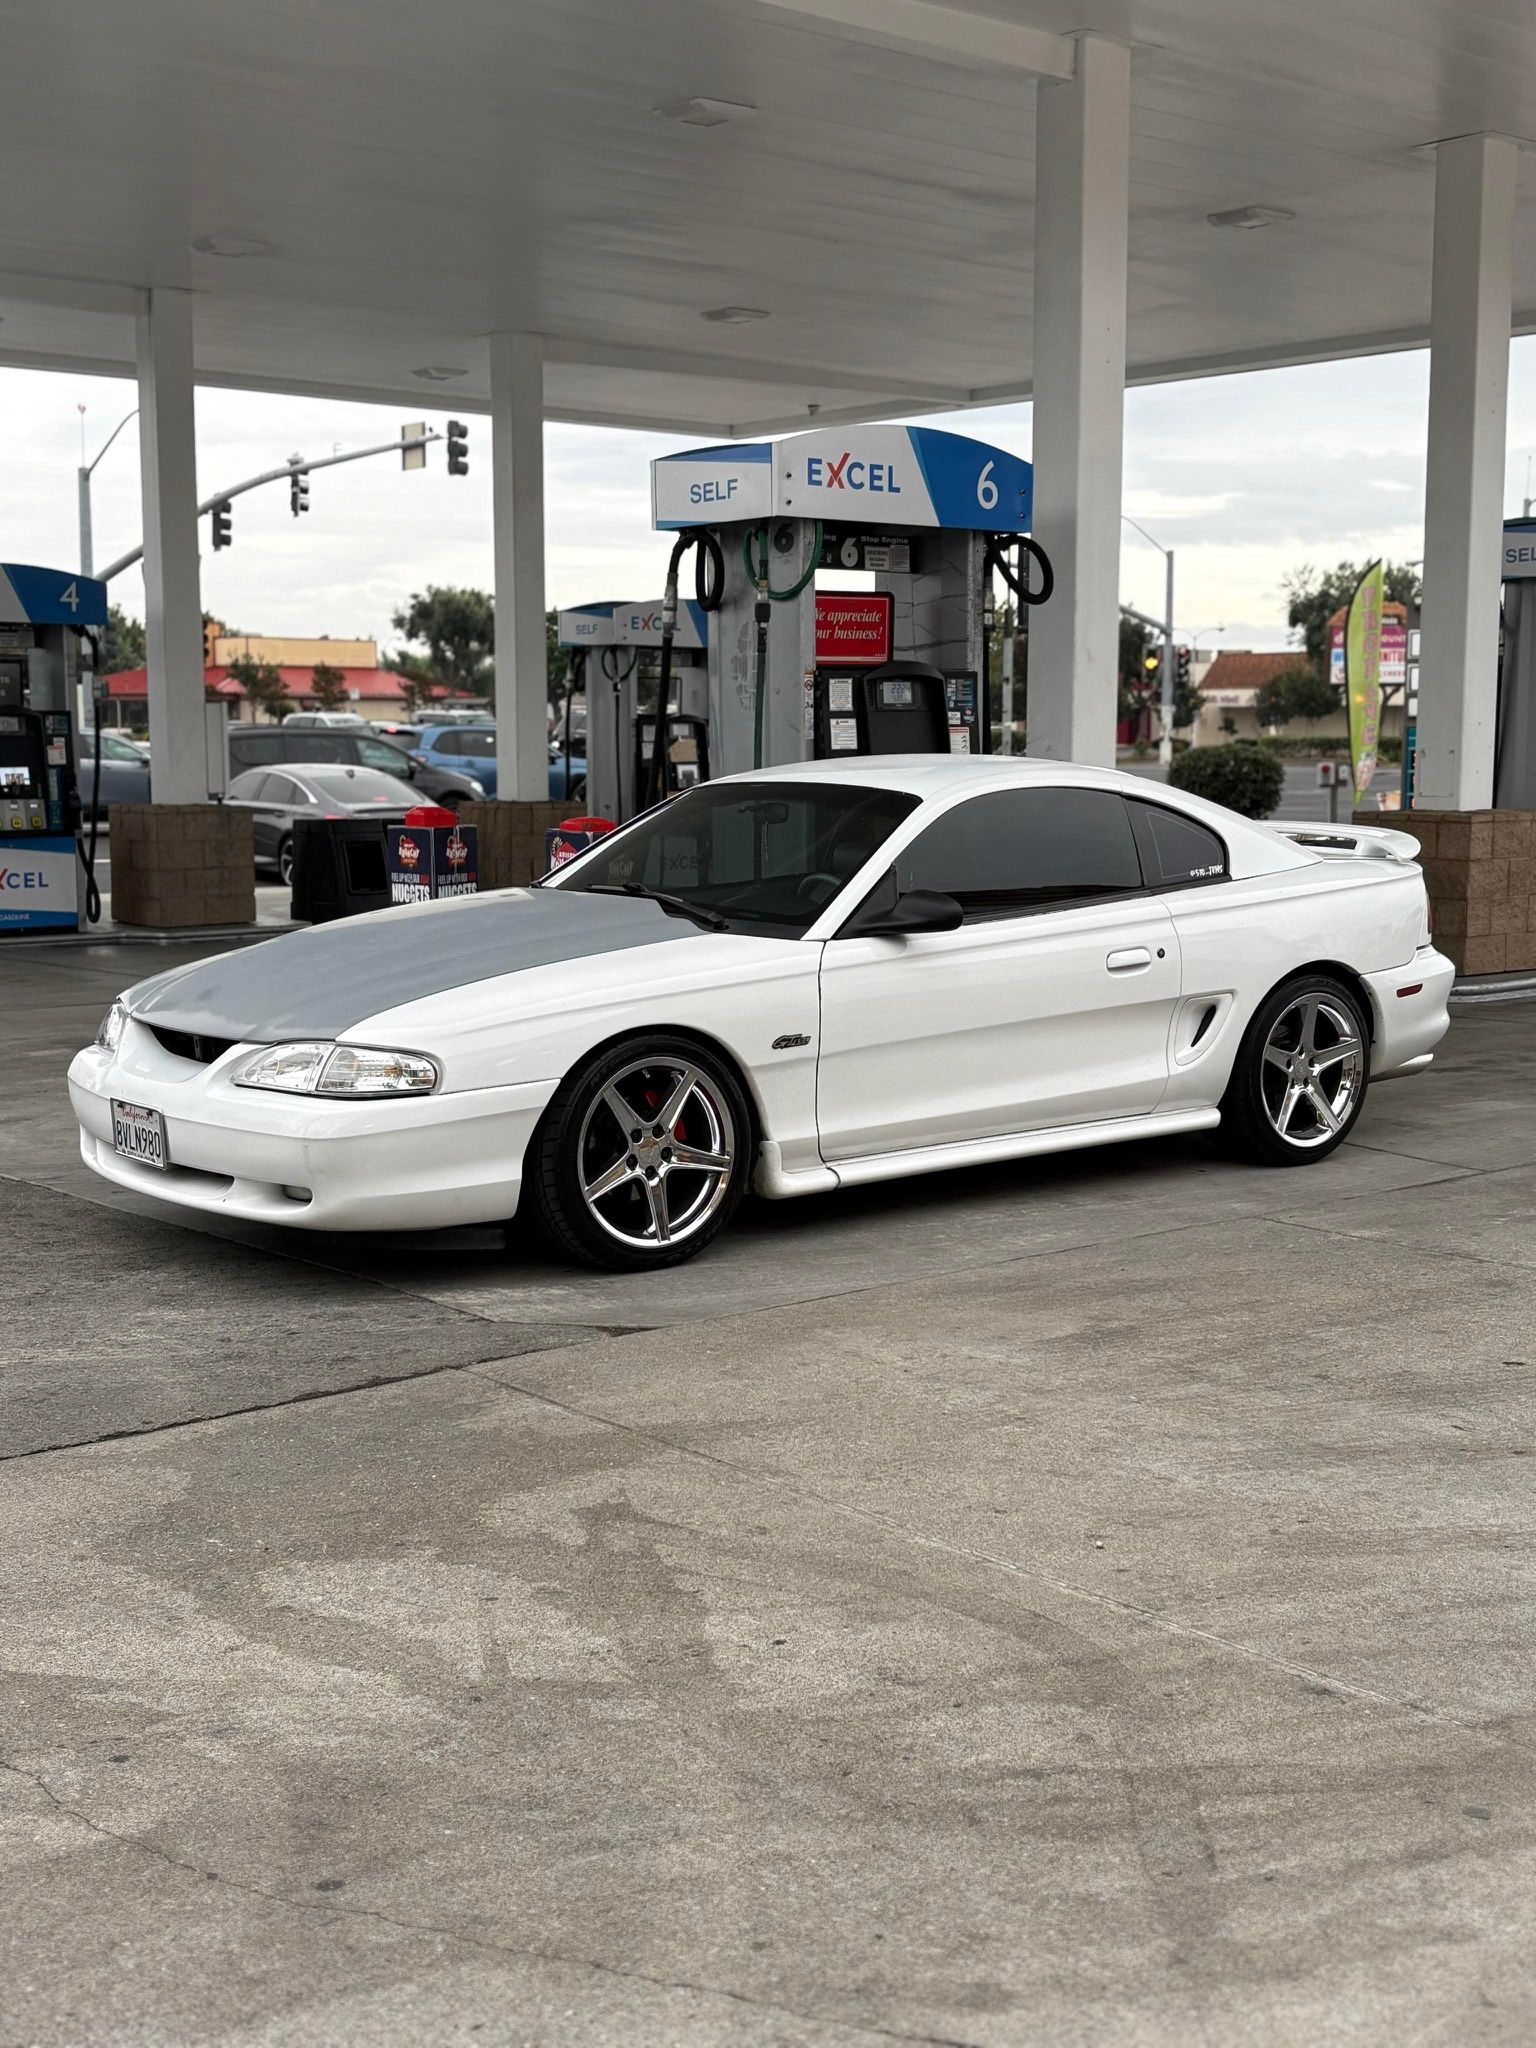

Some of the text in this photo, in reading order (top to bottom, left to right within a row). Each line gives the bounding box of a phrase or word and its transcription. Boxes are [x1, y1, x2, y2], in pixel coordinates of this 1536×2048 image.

[807, 452, 901, 494] EXCEL
[976, 460, 999, 510] 6
[689, 478, 738, 504] SELF
[773, 523, 795, 553] 6
[840, 537, 859, 568] 6
[1505, 547, 1536, 563] SEL
[60, 581, 80, 613] 4
[575, 624, 599, 635] SELF
[631, 612, 682, 632] EXCL
[827, 609, 882, 625] appreciate
[815, 625, 882, 640] our business!
[391, 882, 430, 903] NUGGETS
[116, 1119, 161, 1159] 8VLN980
